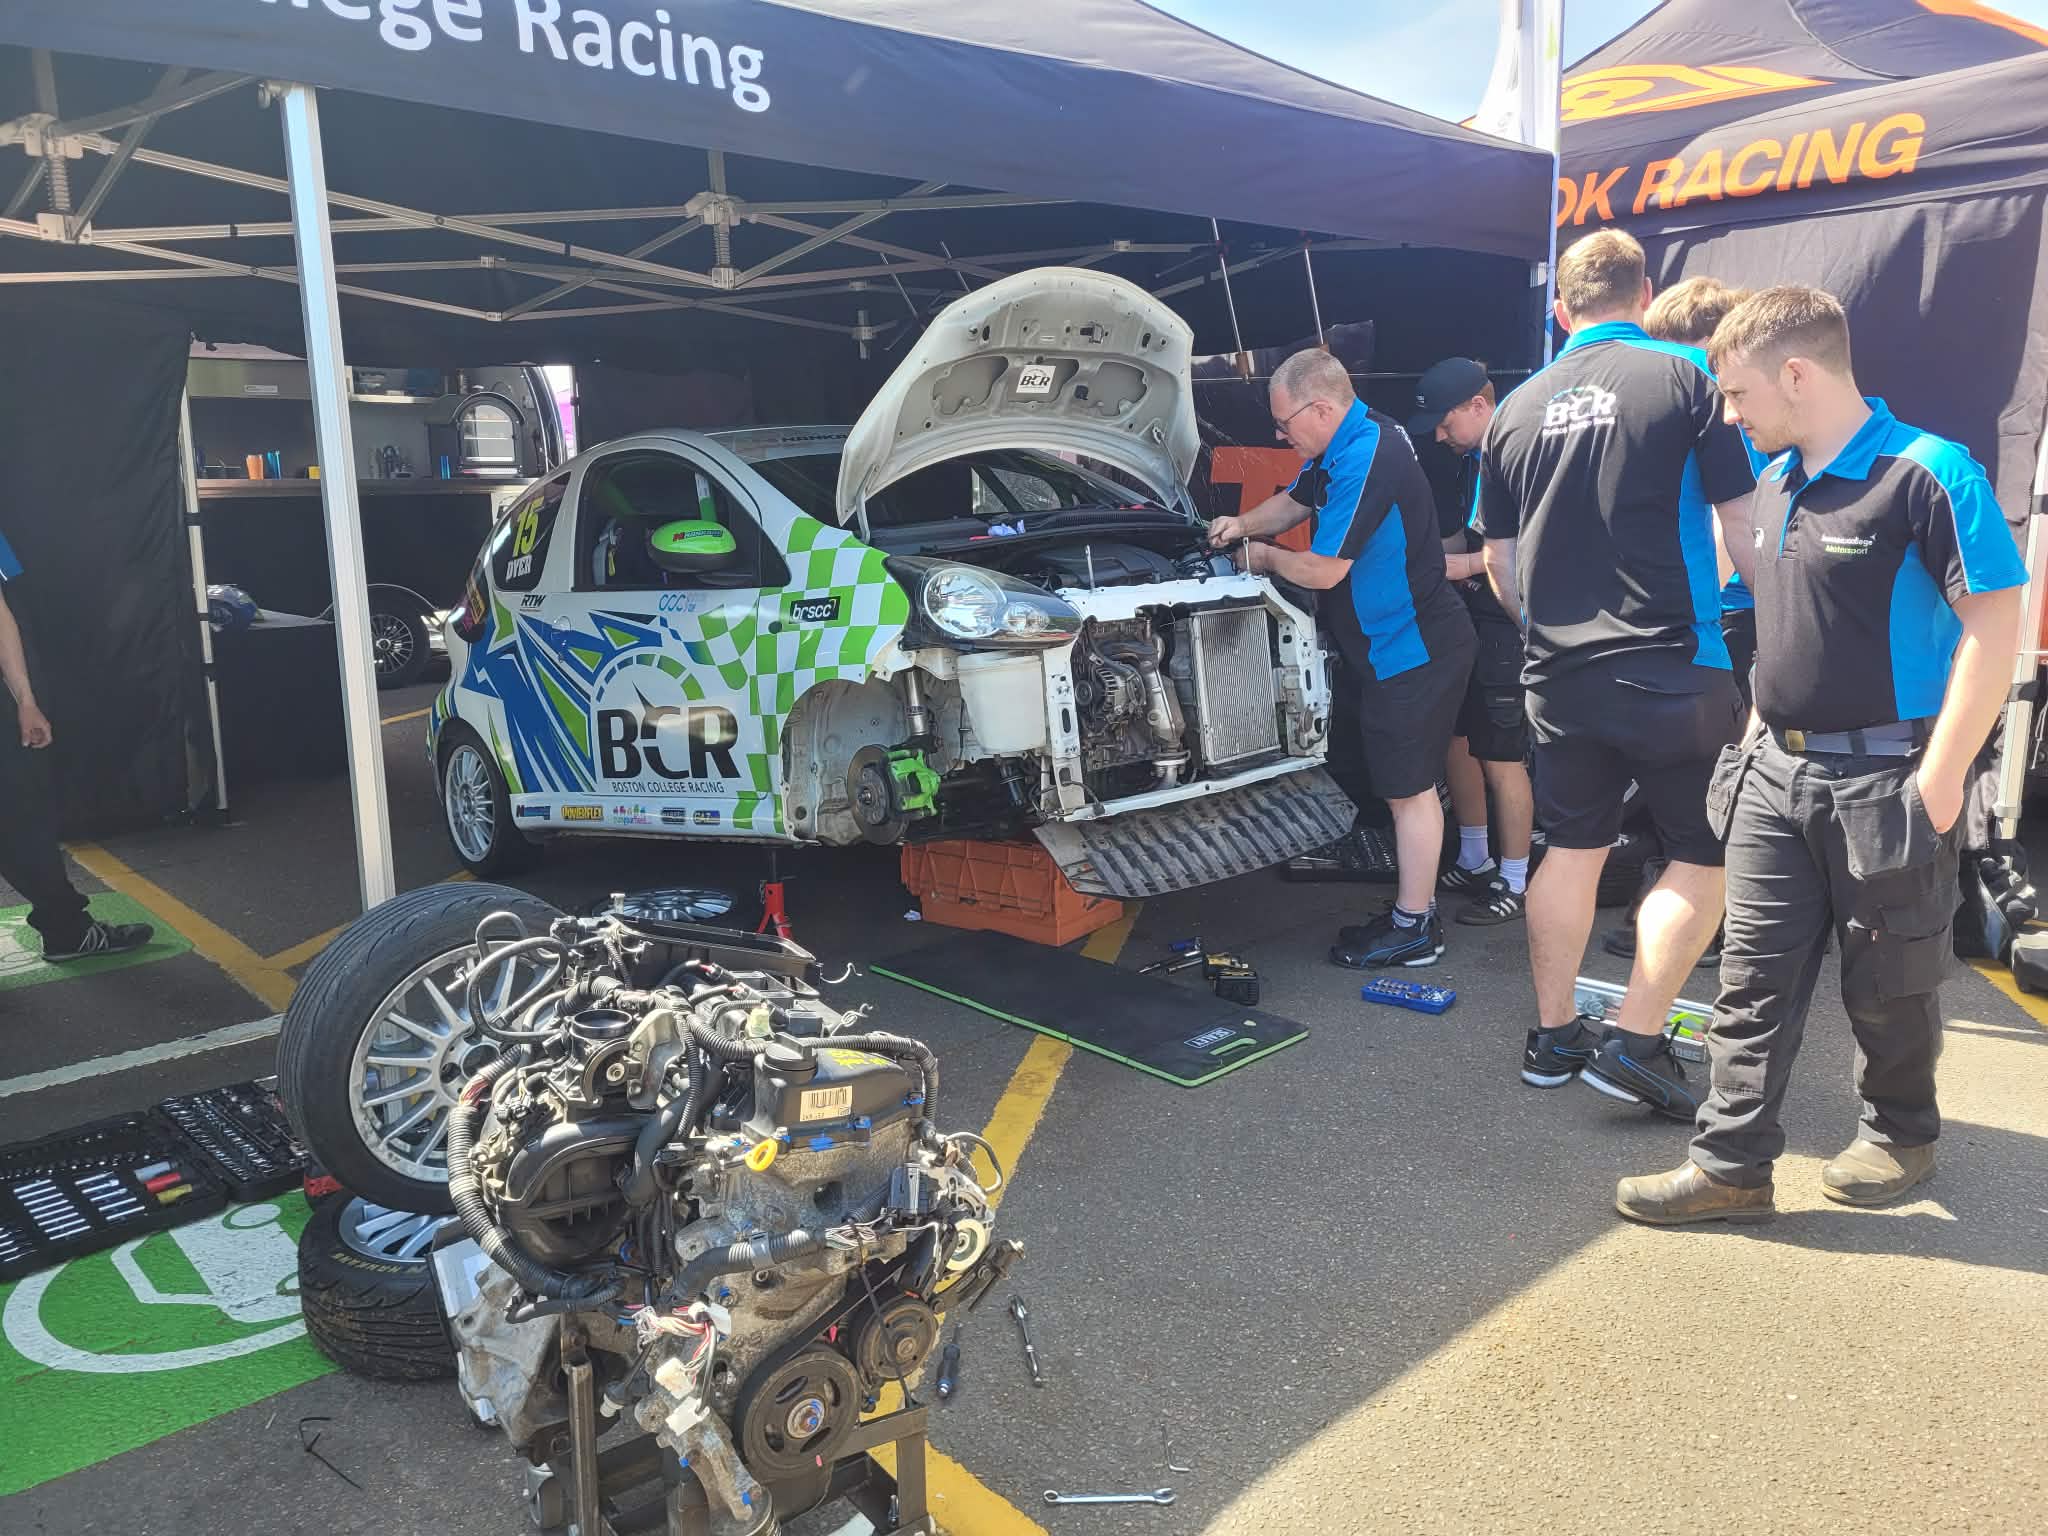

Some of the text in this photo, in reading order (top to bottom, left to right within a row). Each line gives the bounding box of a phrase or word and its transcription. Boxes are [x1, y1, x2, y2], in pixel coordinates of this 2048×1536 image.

[516, 0, 771, 112] Racing
[1632, 112, 1926, 214] RACING
[1020, 375, 1051, 387] BCR
[1543, 391, 1617, 427] BCR
[512, 496, 545, 558] 15
[520, 594, 547, 607] RTW
[792, 603, 832, 620] brscc
[596, 705, 742, 780] BCR
[611, 781, 725, 793] BOSTON COLLEGE RACING
